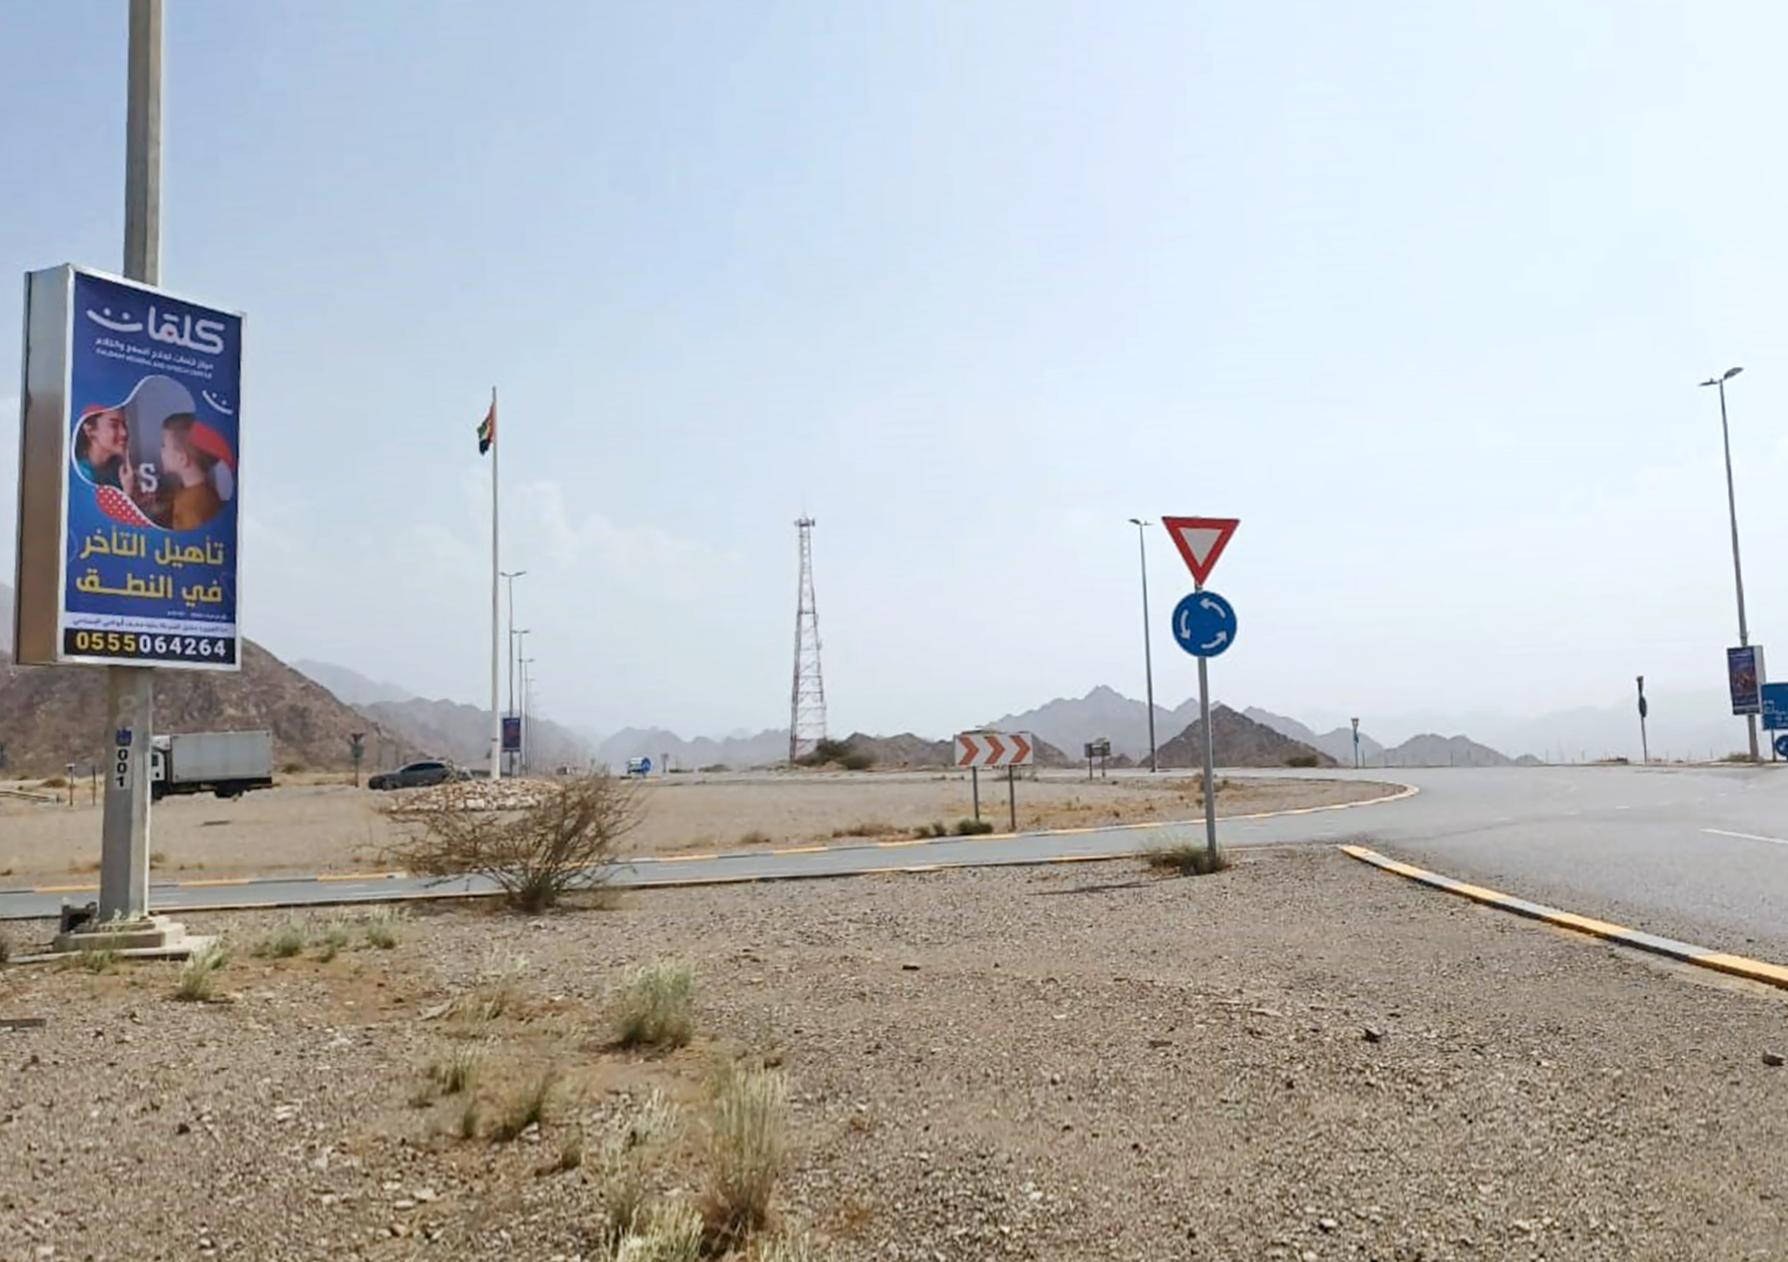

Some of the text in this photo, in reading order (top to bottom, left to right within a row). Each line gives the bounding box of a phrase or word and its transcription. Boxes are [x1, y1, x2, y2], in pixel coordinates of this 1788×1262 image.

[79, 525, 224, 569] تأهيل التأخر
[75, 567, 222, 607] في النطق
[75, 631, 226, 657] 0555064264
